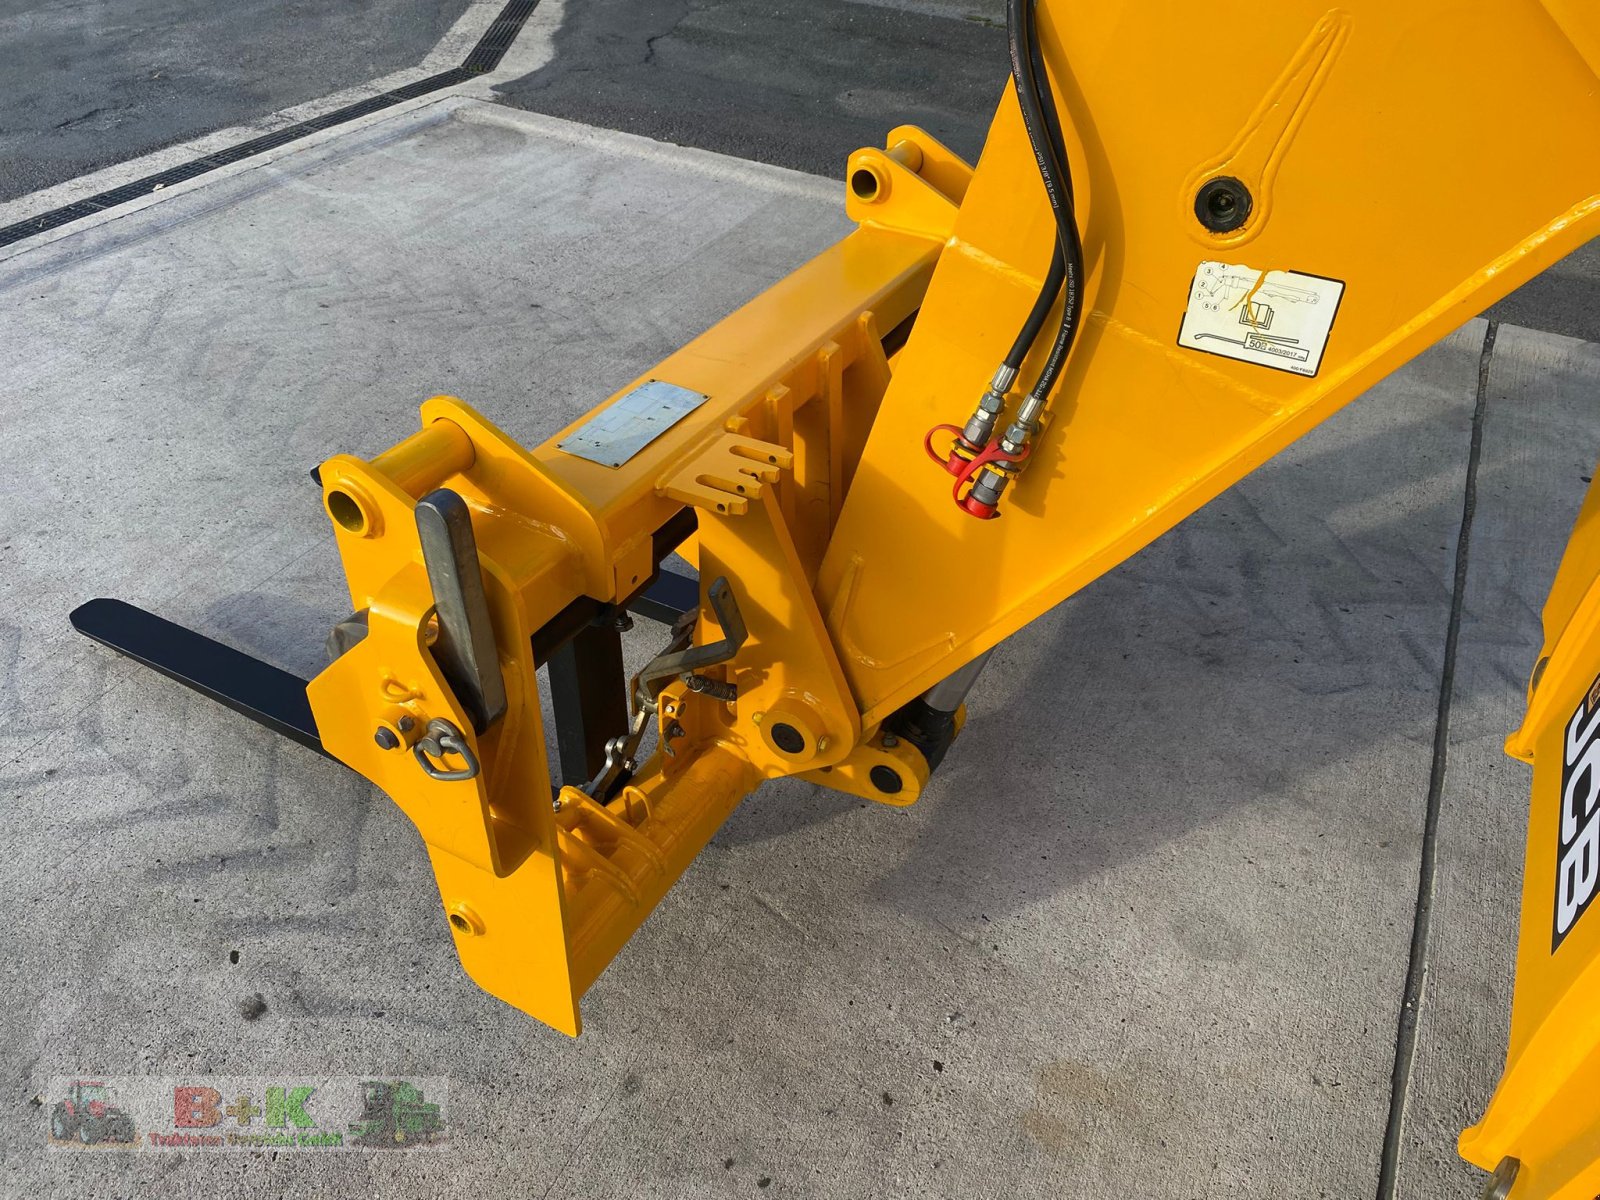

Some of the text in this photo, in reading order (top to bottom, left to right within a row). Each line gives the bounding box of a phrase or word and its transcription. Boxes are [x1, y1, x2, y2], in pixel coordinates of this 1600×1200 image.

[1066, 305, 1074, 317] Type
[1059, 329, 1069, 345] Flame
[1050, 345, 1064, 367] Resistant
[1043, 367, 1054, 381] MSHA
